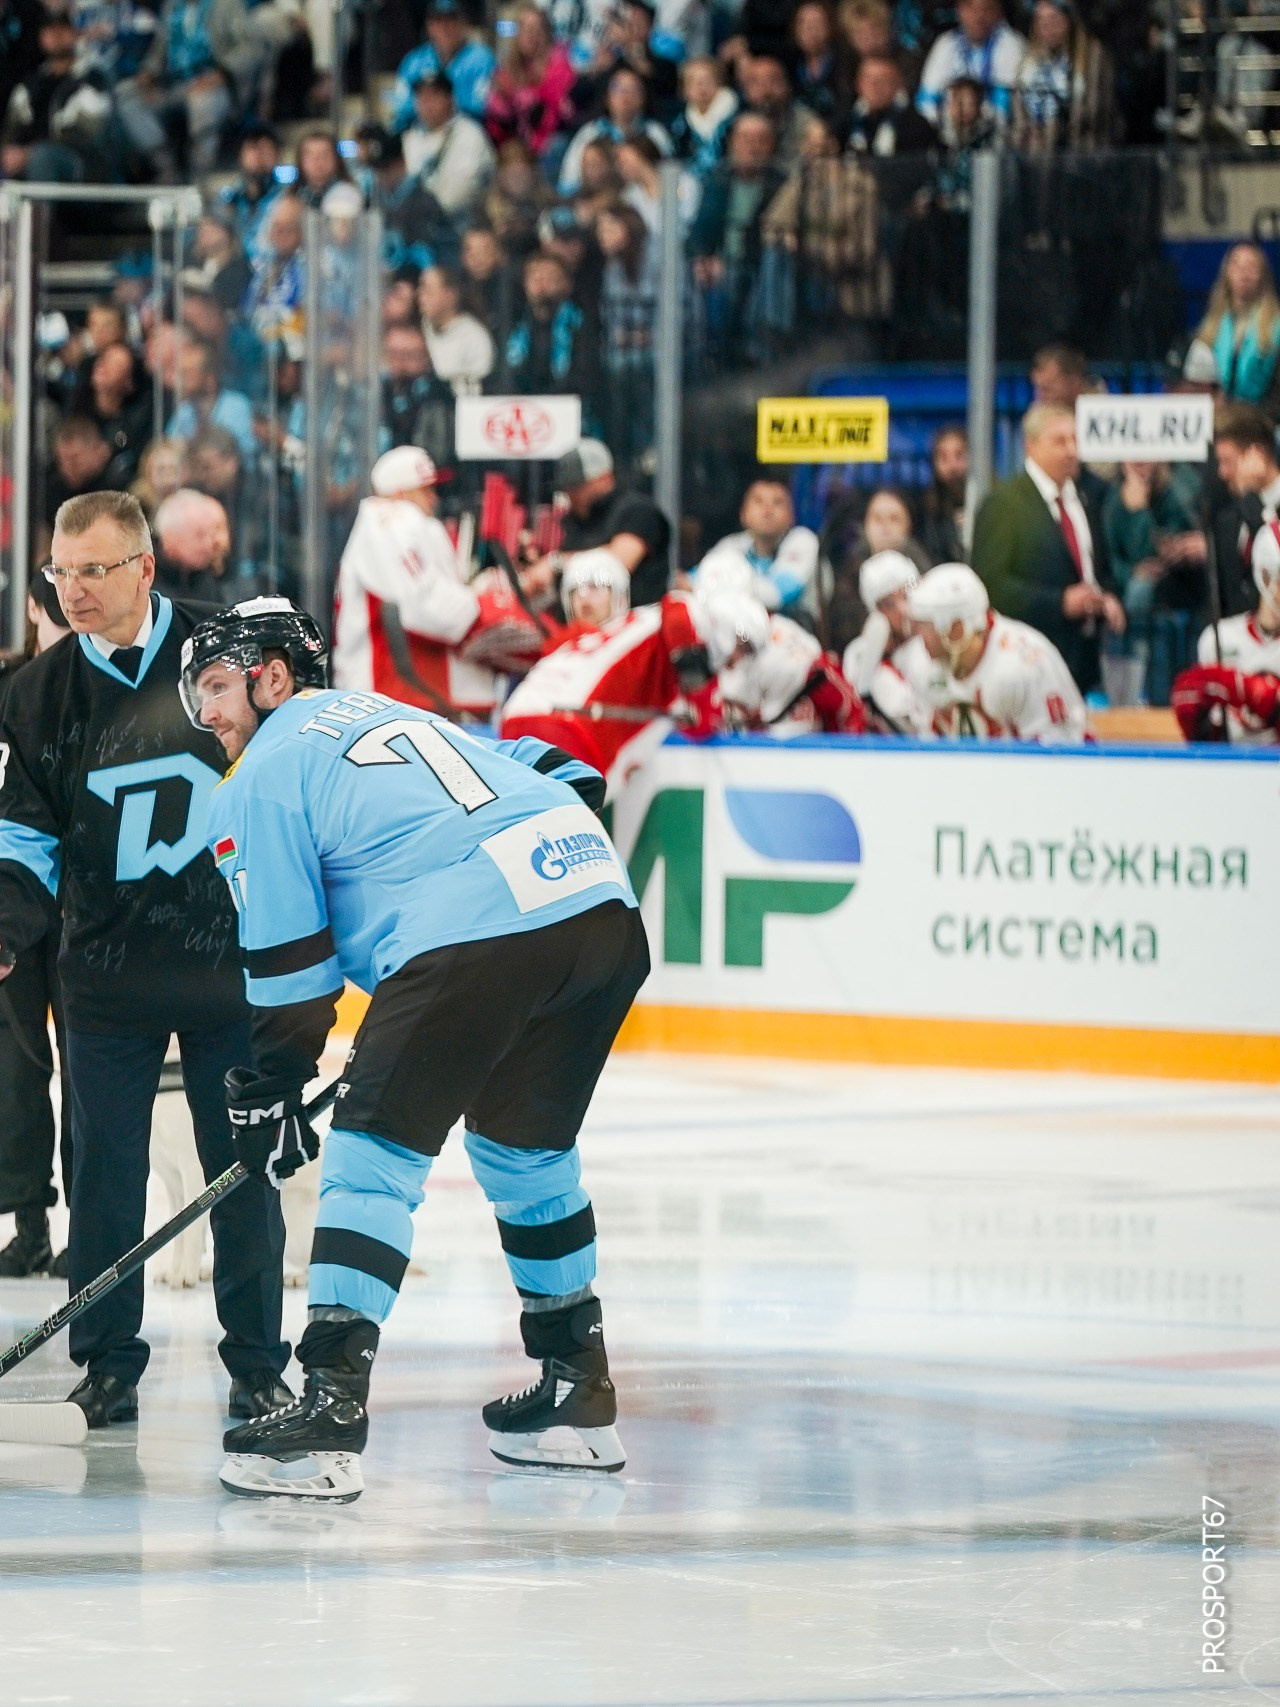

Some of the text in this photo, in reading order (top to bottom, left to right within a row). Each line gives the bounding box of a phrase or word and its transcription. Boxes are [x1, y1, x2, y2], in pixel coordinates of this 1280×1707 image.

[1087, 409, 1203, 442] KHL.RU
[299, 693, 395, 740] TIER
[342, 718, 499, 816] 7
[932, 826, 1250, 887] Платёжная
[930, 912, 1160, 963] система
